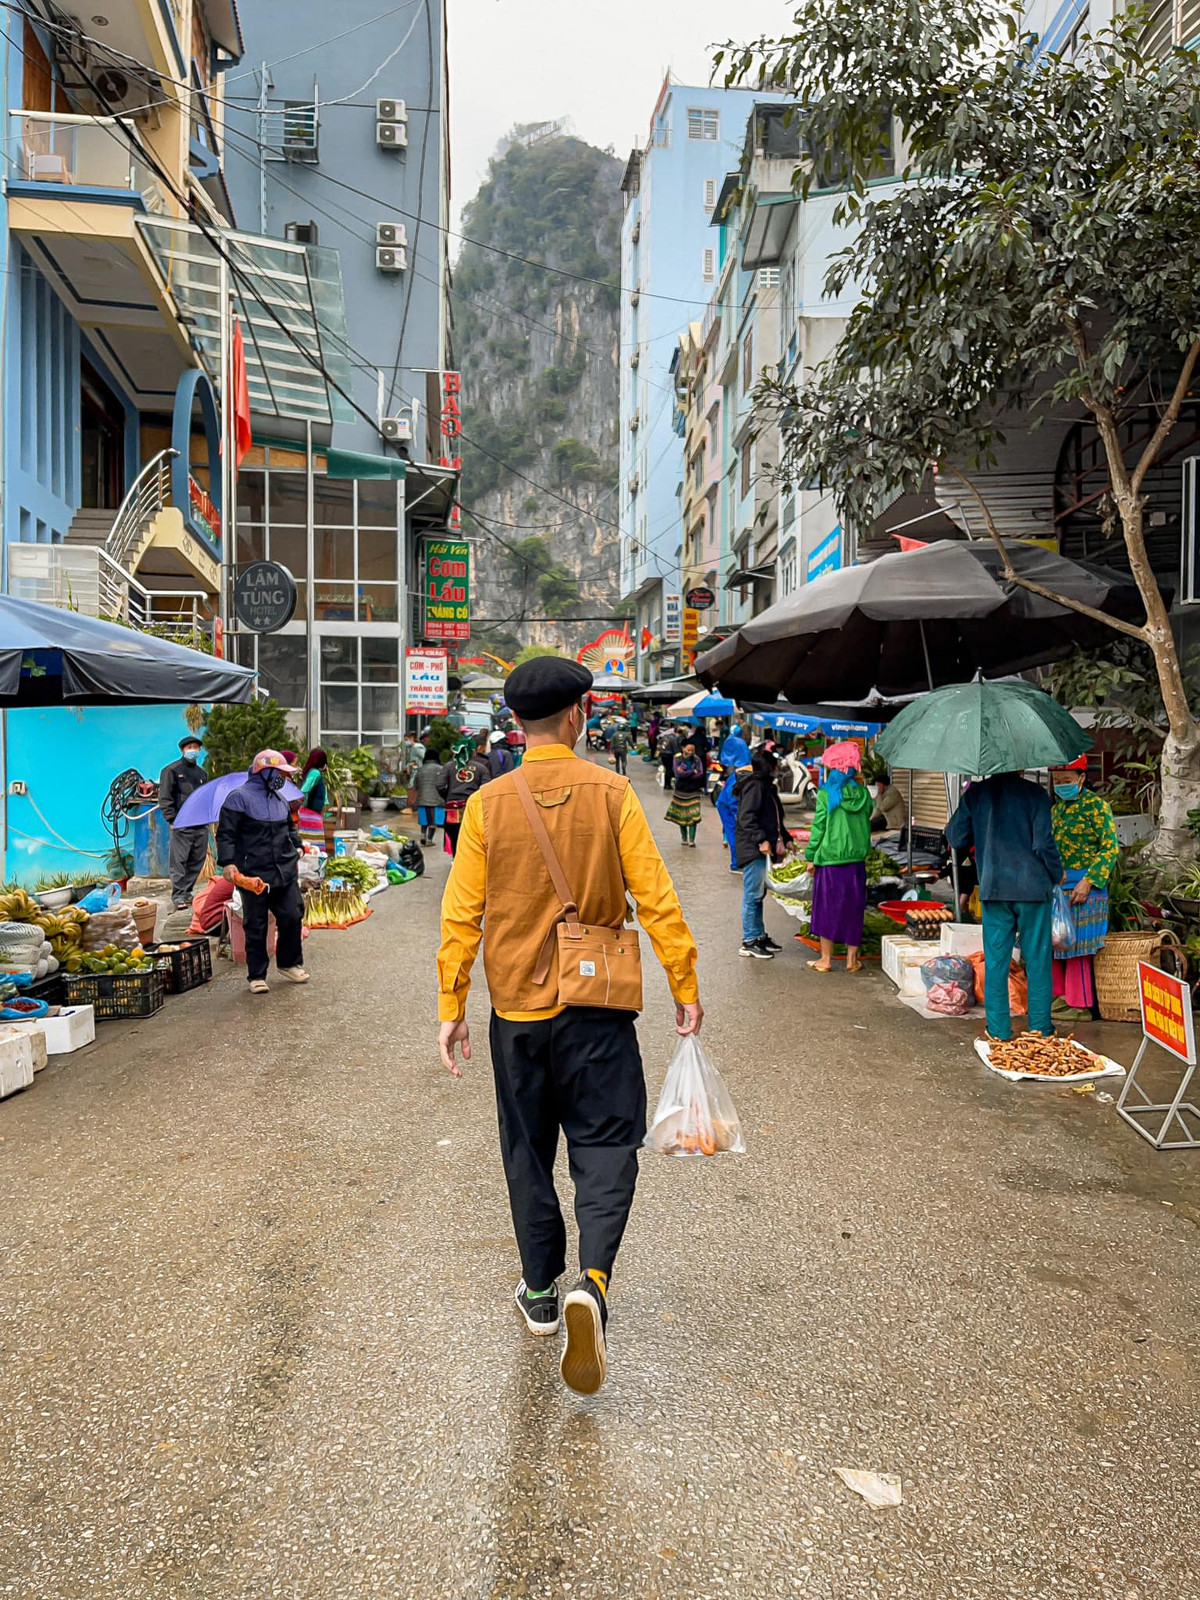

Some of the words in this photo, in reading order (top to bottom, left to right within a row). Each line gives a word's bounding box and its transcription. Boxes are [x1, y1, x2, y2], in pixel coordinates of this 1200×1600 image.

[246, 568, 279, 587] LÂM
[241, 587, 285, 606] TÙNG
[250, 606, 278, 616] HOTEL
[784, 720, 809, 731] VNPT
